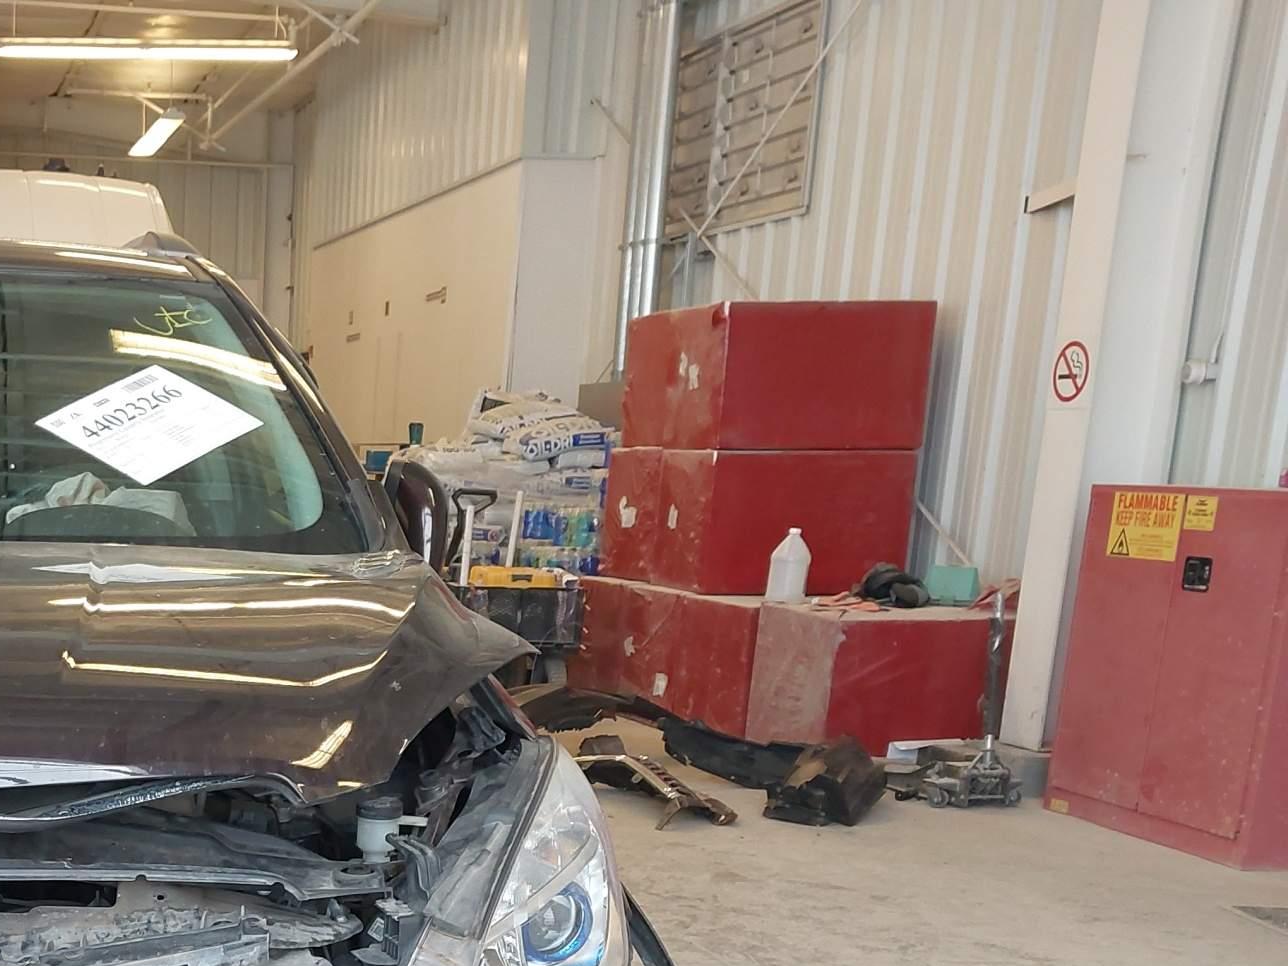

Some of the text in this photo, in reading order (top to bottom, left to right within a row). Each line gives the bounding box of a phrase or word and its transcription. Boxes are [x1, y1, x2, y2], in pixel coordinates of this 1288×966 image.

[81, 384, 184, 439] 44023266
[1117, 494, 1179, 512] FLAMMABLE
[1115, 510, 1134, 527] KEEP
[1134, 511, 1152, 527] FIRE
[1152, 512, 1176, 529] AWAY
